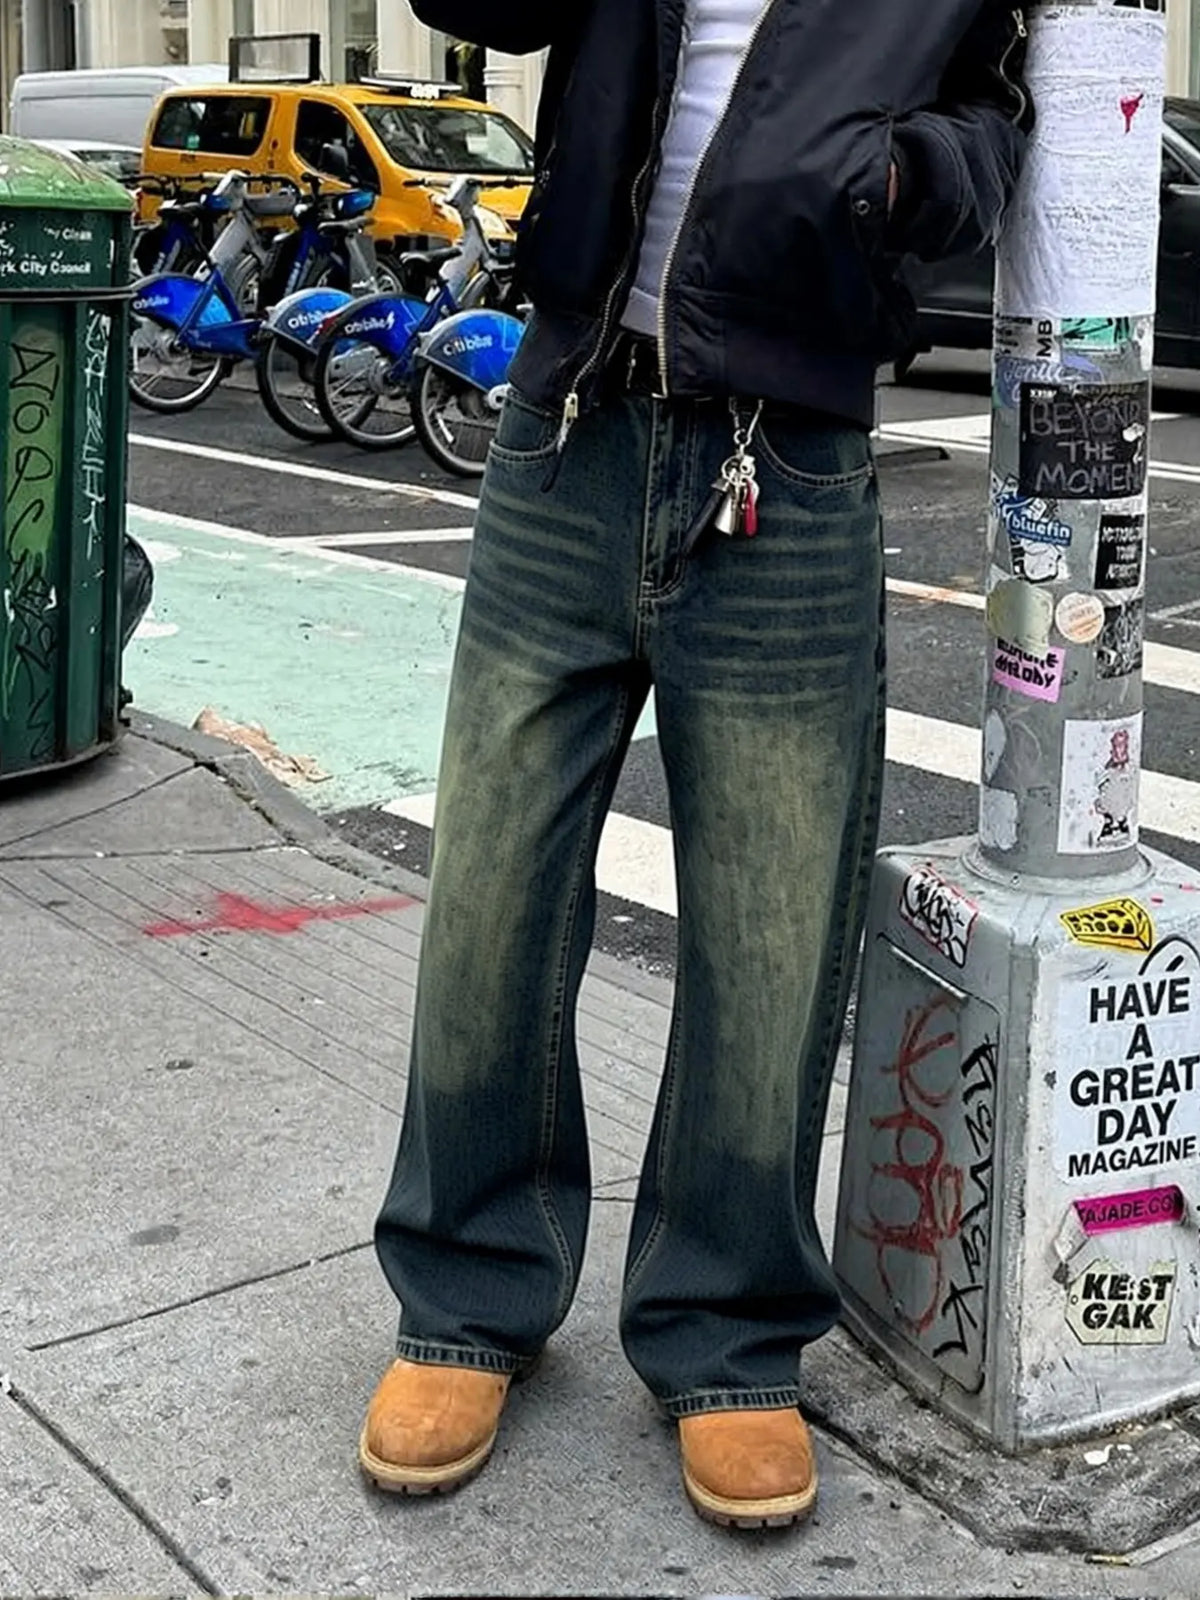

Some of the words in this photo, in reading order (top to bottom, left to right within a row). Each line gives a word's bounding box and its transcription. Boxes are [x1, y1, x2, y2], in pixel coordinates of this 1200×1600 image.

[20, 261, 47, 276] City
[1029, 400, 1142, 440] BEYOND
[1056, 440, 1115, 463] THE
[1011, 513, 1070, 538] bluefin
[1089, 976, 1190, 1023] HAVE
[1126, 1022, 1153, 1060] A
[1070, 1055, 1200, 1107] GREAT
[1097, 1099, 1178, 1146] DAY
[1082, 1303, 1157, 1330] GAK
